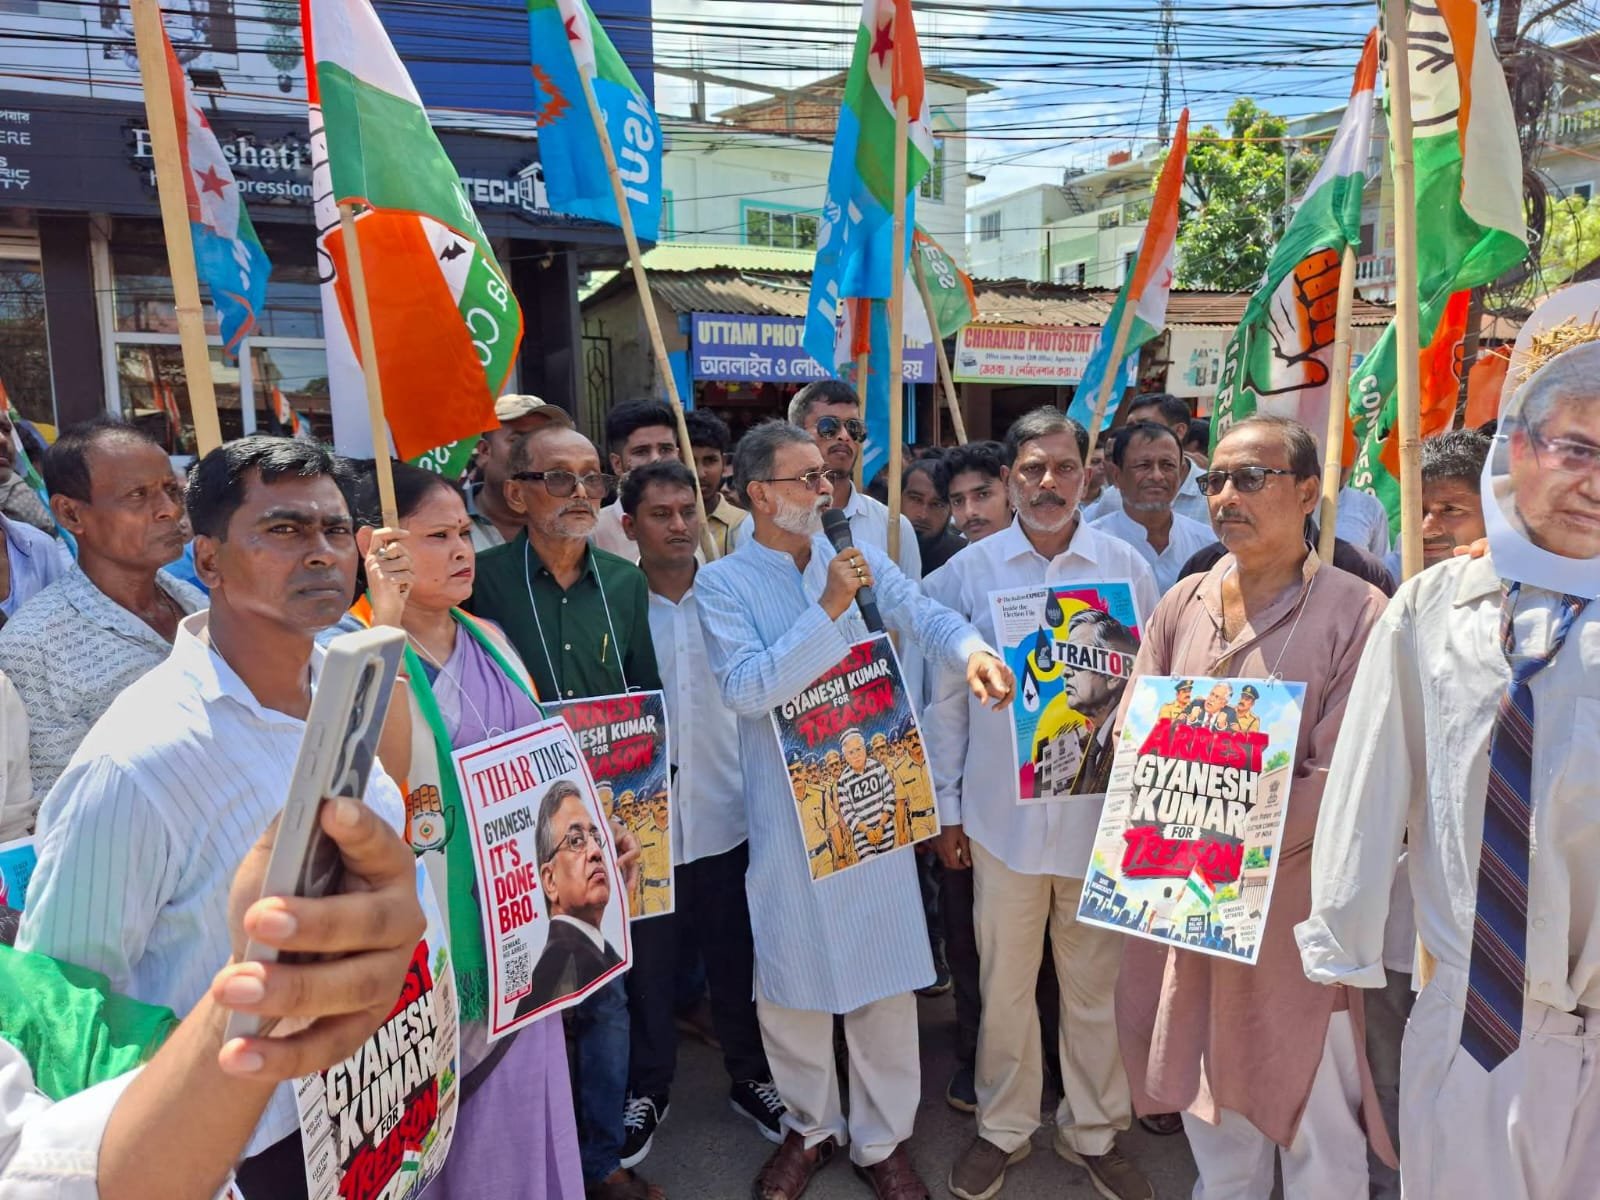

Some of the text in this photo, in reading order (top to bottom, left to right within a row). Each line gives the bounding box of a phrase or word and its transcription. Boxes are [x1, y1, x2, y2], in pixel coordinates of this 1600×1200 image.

[698, 321, 758, 346] UTTAM
[964, 328, 1093, 352] CHIRANJIB PHOTOSTAT
[700, 352, 772, 377] অনলাইন
[774, 359, 787, 375] ও
[1056, 642, 1133, 677] TRAITOR
[781, 658, 892, 720] GYANESH KUMAR
[832, 694, 850, 707] FOR
[611, 715, 658, 741] KUMAR
[797, 678, 894, 748] TREASON
[591, 744, 609, 756] FOR
[1137, 717, 1269, 772] ARREST
[471, 755, 537, 808] TIHAR
[529, 739, 578, 784] TIMES
[853, 776, 879, 798] 420
[1133, 754, 1260, 804] GYANESH
[483, 806, 536, 846] GYANESH,
[1131, 787, 1248, 840] KUMAR
[1172, 826, 1194, 838] FOR
[1121, 825, 1245, 884] TREASON
[494, 862, 537, 906] DONE
[498, 899, 539, 935] BRO.
[326, 990, 437, 1118] GYANESH
[340, 1034, 438, 1168] KUMAR
[380, 1107, 399, 1139] FOR
